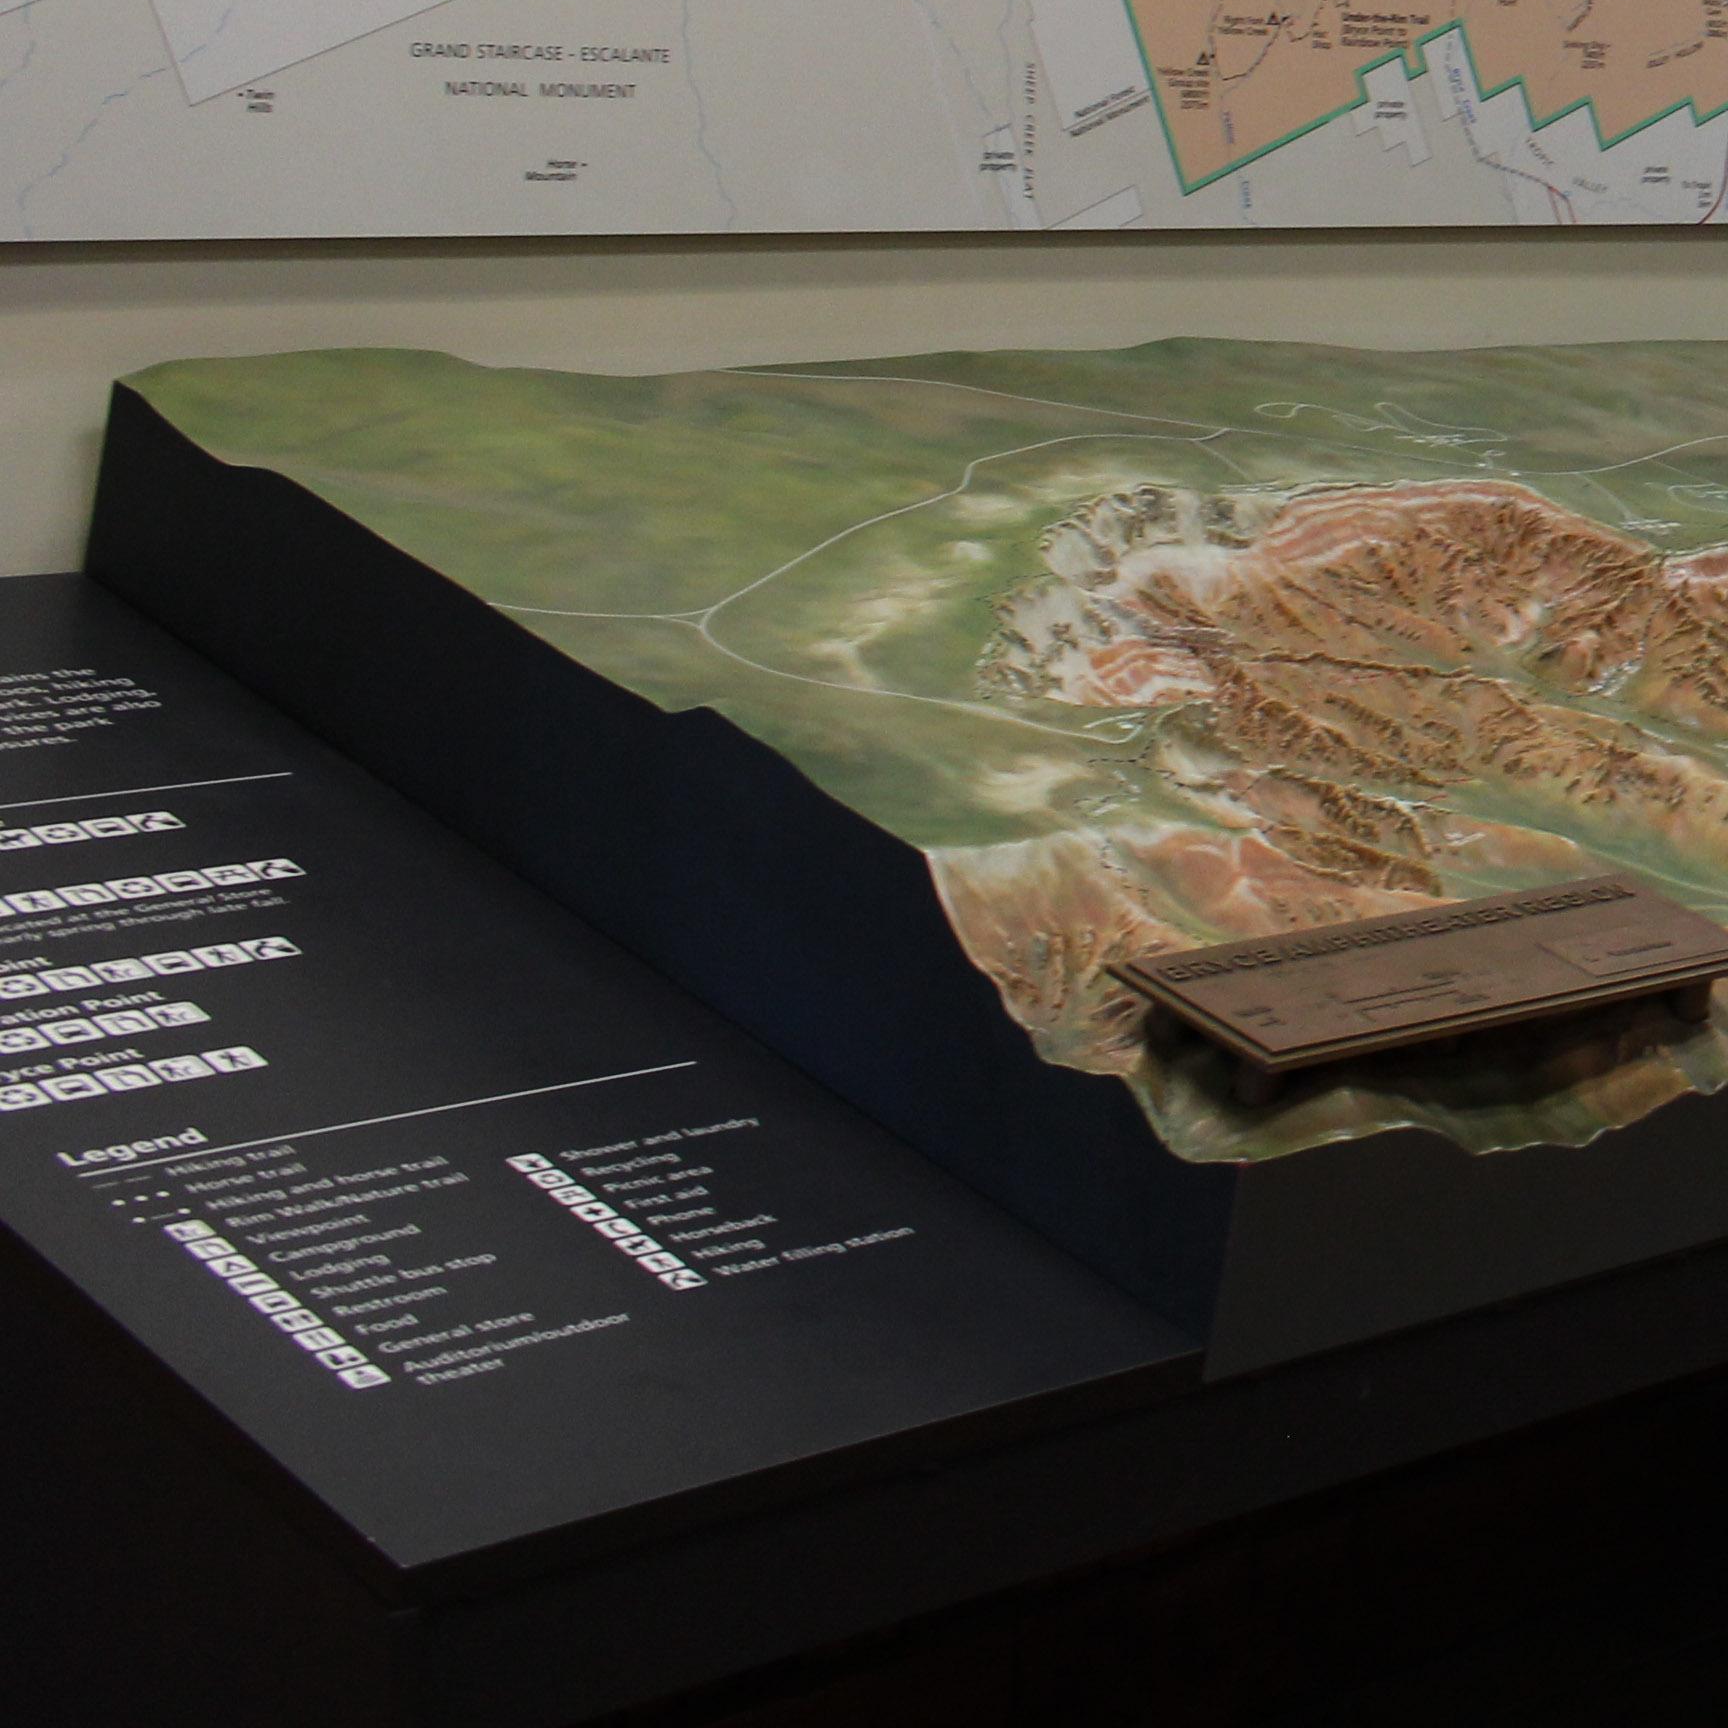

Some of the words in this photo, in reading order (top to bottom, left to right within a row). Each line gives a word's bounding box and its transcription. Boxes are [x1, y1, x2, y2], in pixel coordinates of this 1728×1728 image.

[410, 42, 469, 60] GRAND
[476, 43, 563, 62] STAIRCASE
[579, 46, 671, 64] ESCALANTE
[444, 81, 529, 98] NATIONAL
[539, 82, 637, 99] MONUMENT
[54, 677, 136, 692] hiking
[132, 894, 216, 914] General
[217, 887, 272, 904] Store
[119, 907, 206, 928] through
[1165, 946, 1283, 983] BRYCE
[81, 991, 167, 1013] Point
[56, 1048, 146, 1071] Point
[55, 1127, 210, 1168] Legend
[558, 1141, 638, 1162] Shower
[641, 1130, 682, 1146] and
[681, 1116, 760, 1138] laundry
[164, 1154, 248, 1177] Hiking
[245, 1144, 297, 1162] trail
[579, 1152, 681, 1178] Recycling
[184, 1173, 256, 1194] Horse
[256, 1161, 308, 1180] trail
[205, 1188, 288, 1211] Hiking
[288, 1177, 335, 1195] and
[333, 1166, 399, 1186] horse
[400, 1155, 450, 1172] trail
[601, 1176, 665, 1194] Picnic
[666, 1165, 715, 1182] area
[225, 1212, 277, 1229] Rim
[274, 1182, 420, 1220] Walk/Nature
[420, 1172, 470, 1189] trail
[623, 1194, 673, 1211] First
[674, 1185, 710, 1202] aid
[246, 1213, 373, 1246] Viewpoint
[646, 1205, 717, 1226] Phone
[668, 1214, 779, 1244] Horseback
[267, 1223, 422, 1263] Campground
[690, 1238, 767, 1260] Hiking
[711, 1255, 780, 1277] Water
[780, 1242, 848, 1262] filling
[845, 1227, 917, 1249] station
[288, 1253, 392, 1282] Lodging
[309, 1274, 398, 1301] Shuttle
[397, 1264, 445, 1280] bus
[445, 1252, 497, 1270] stop
[332, 1286, 449, 1317] Restroom
[354, 1313, 420, 1336] Food
[377, 1324, 474, 1354] General
[475, 1311, 536, 1332] store
[402, 1312, 631, 1373] Auditorium/outdoor
[416, 1358, 504, 1387] theater
